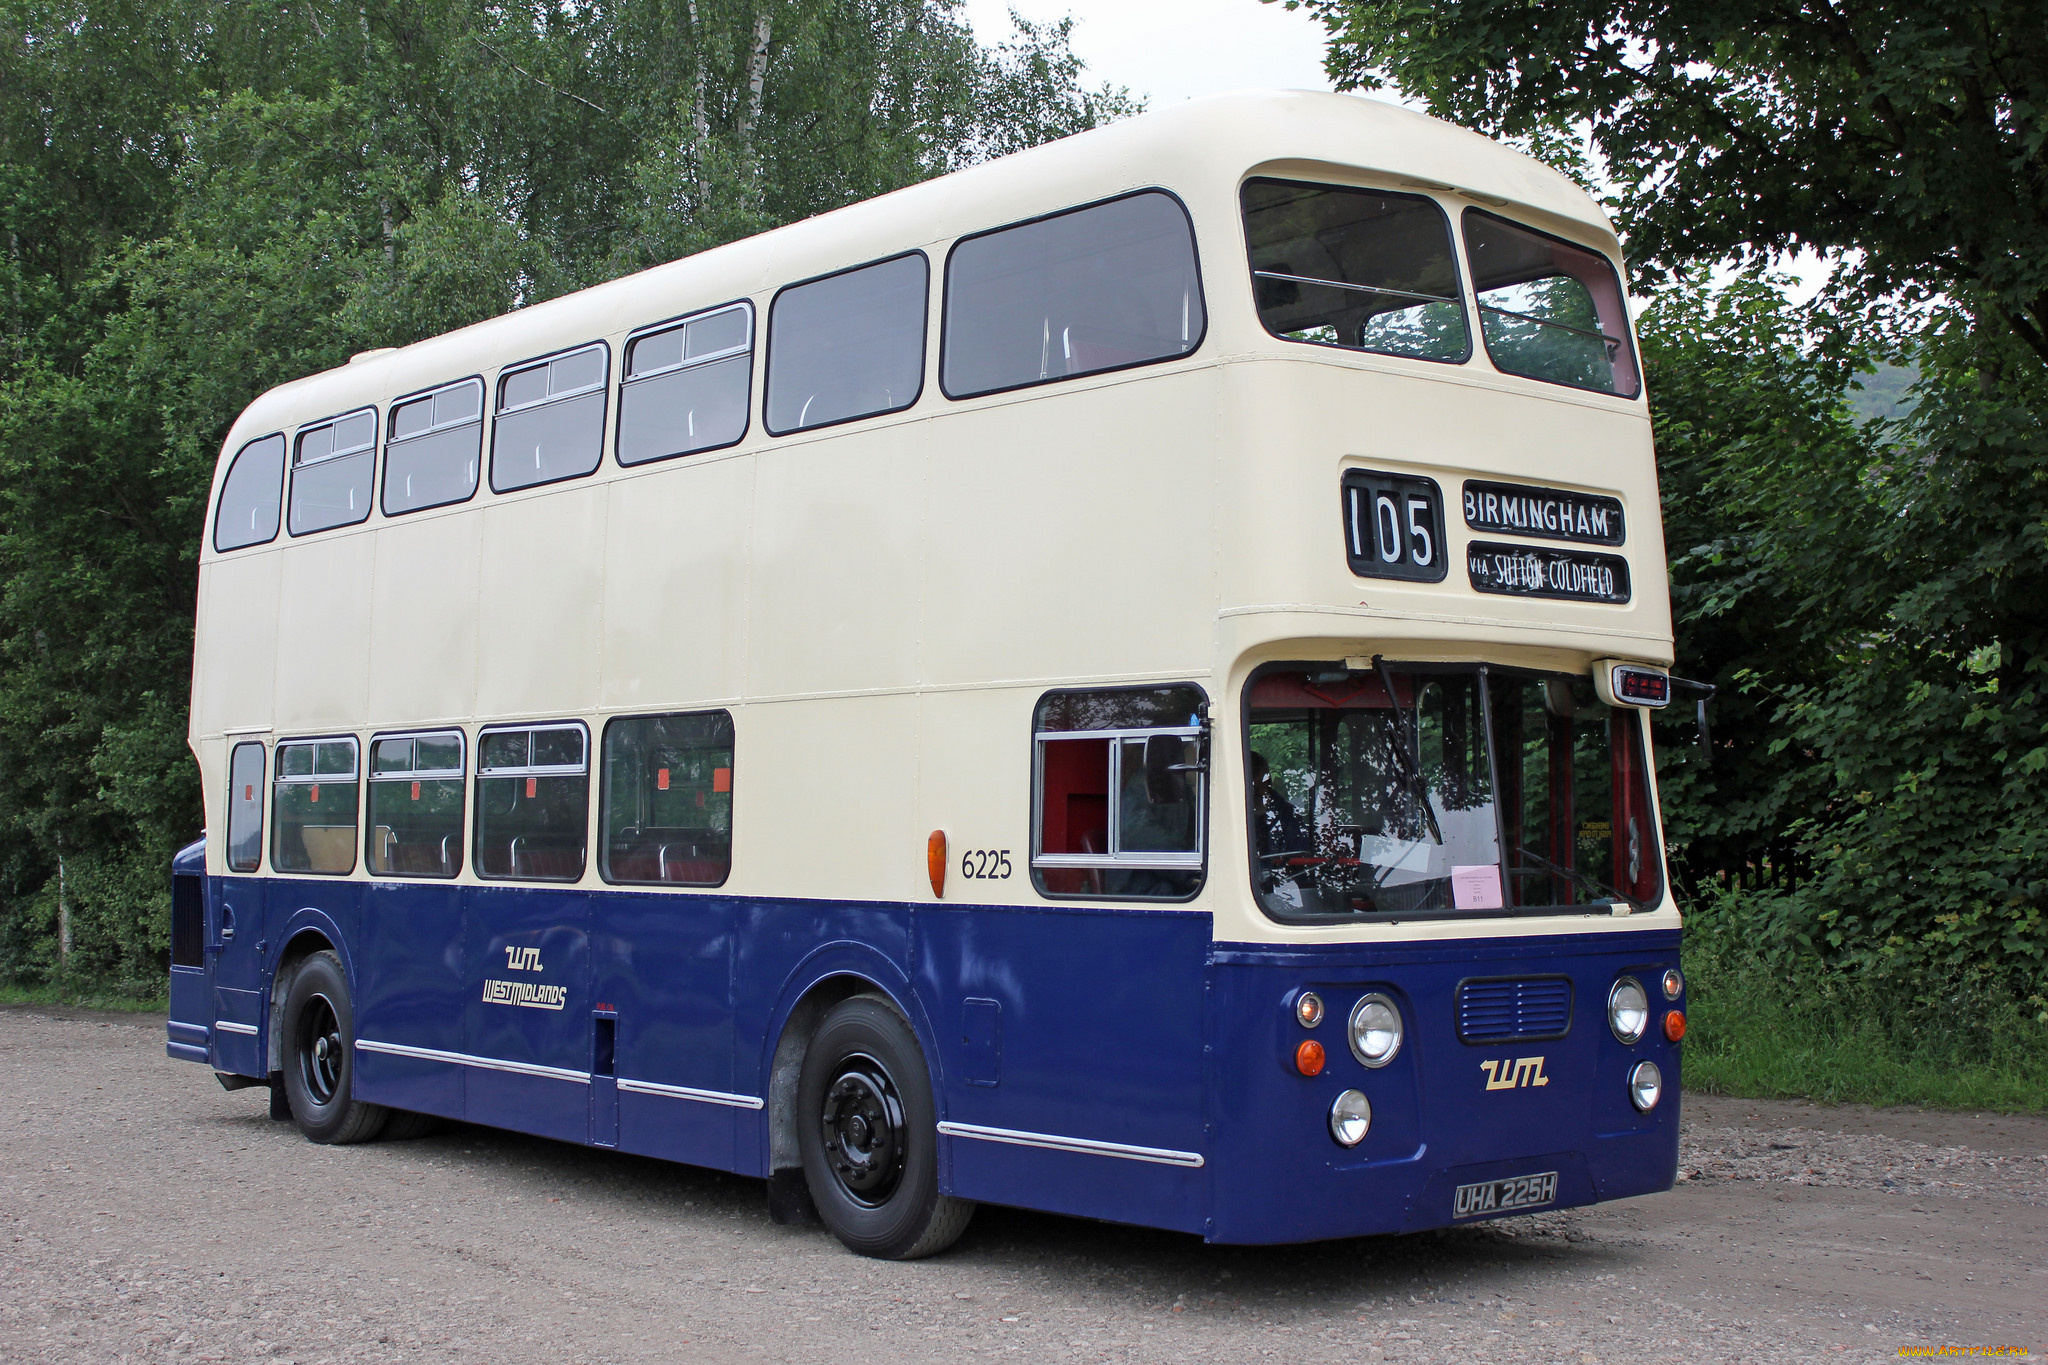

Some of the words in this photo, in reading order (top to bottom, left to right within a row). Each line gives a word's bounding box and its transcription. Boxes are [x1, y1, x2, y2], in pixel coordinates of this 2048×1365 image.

[1350, 487, 1432, 567] 105
[1465, 491, 1609, 537] BIRMINGHAM
[1469, 557, 1490, 576] VIA
[1494, 554, 1544, 588] SUTTON
[1549, 561, 1614, 595] COLDFIELD
[962, 849, 1012, 879] 6225
[1457, 1184, 1496, 1213] UHA
[1501, 1175, 1555, 1207] 225H
